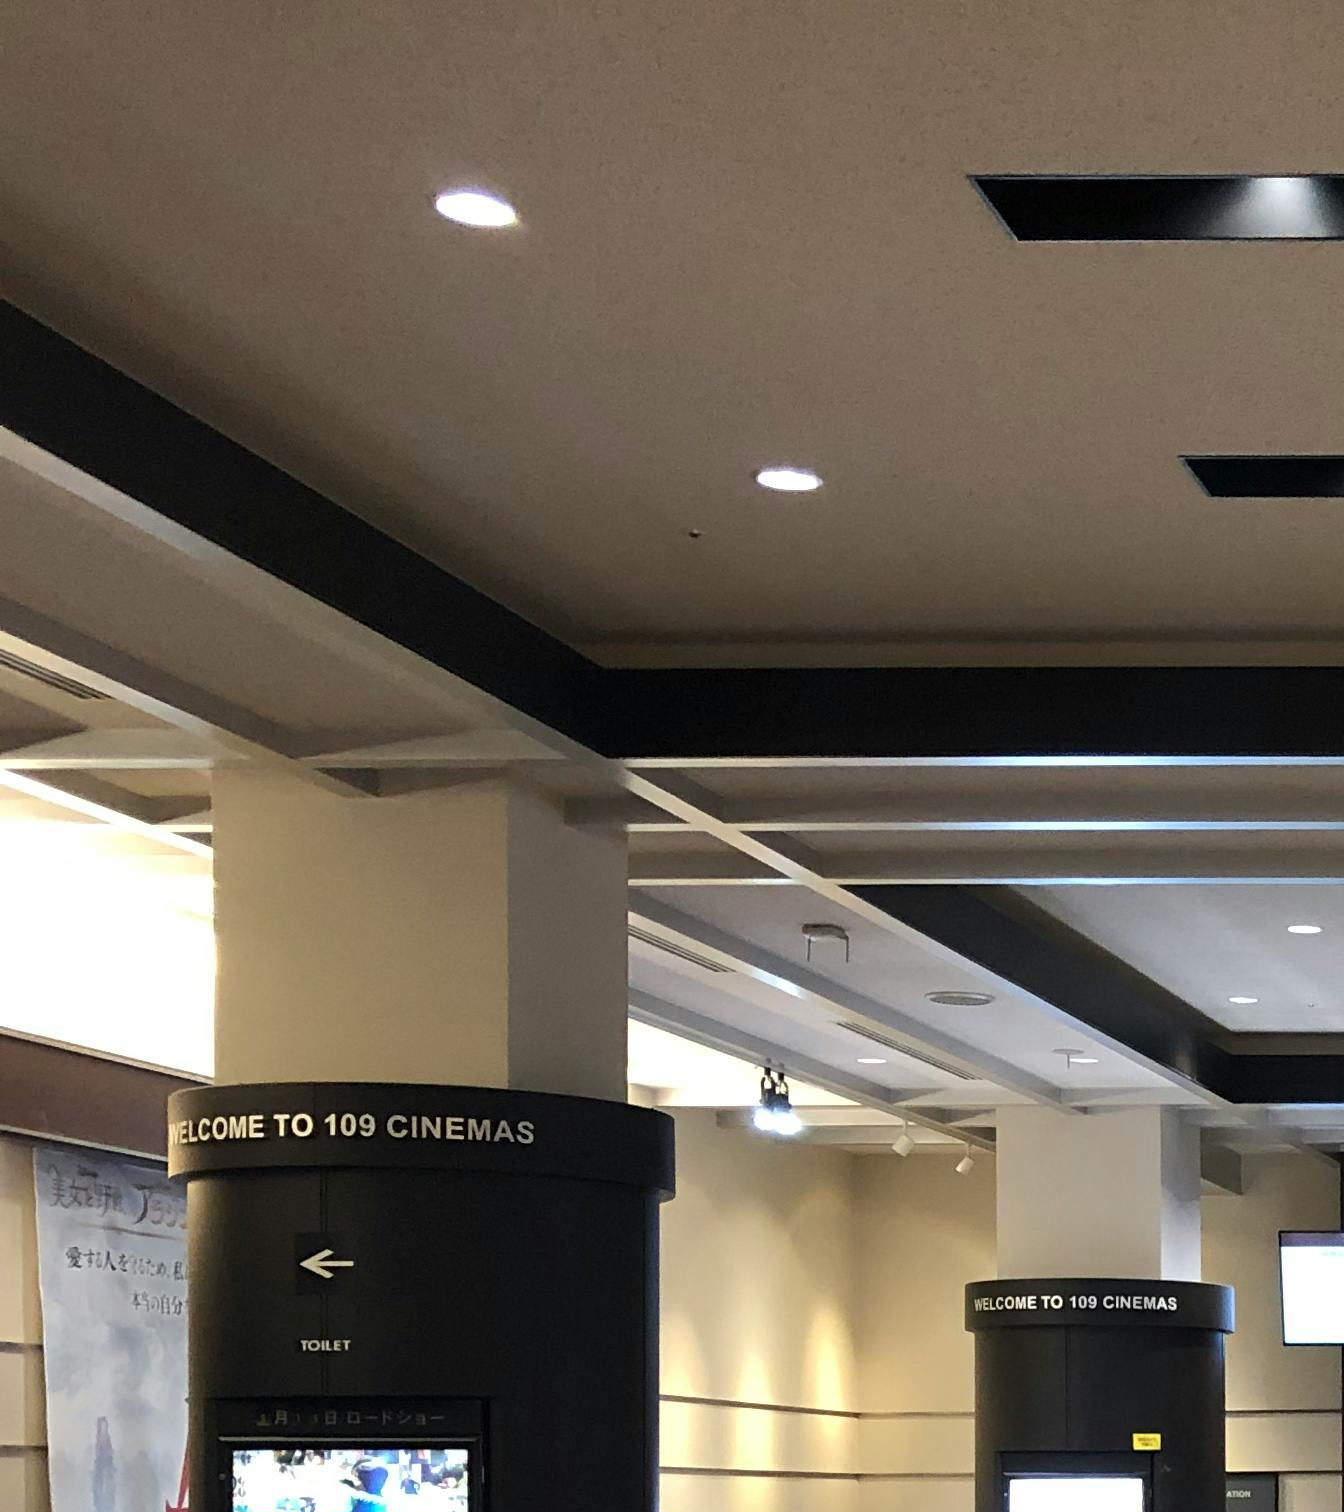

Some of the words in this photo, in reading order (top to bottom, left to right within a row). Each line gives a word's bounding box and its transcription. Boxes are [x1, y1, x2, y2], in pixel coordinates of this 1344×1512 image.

[169, 1114, 264, 1146] WELCOME
[273, 1113, 313, 1138] TO
[324, 1113, 376, 1138] 109
[387, 1115, 535, 1145] CINEMAS
[65, 1246, 187, 1280] 愛する人を守るため、私
[131, 1289, 187, 1315] 本当の自分
[974, 1295, 1037, 1312] WELCOME
[1041, 1295, 1063, 1310] TO
[1069, 1295, 1097, 1309] 109
[1102, 1295, 1177, 1311] CINEMAS
[301, 1340, 350, 1351] TOILET
[347, 1410, 445, 1426] ロードショー
